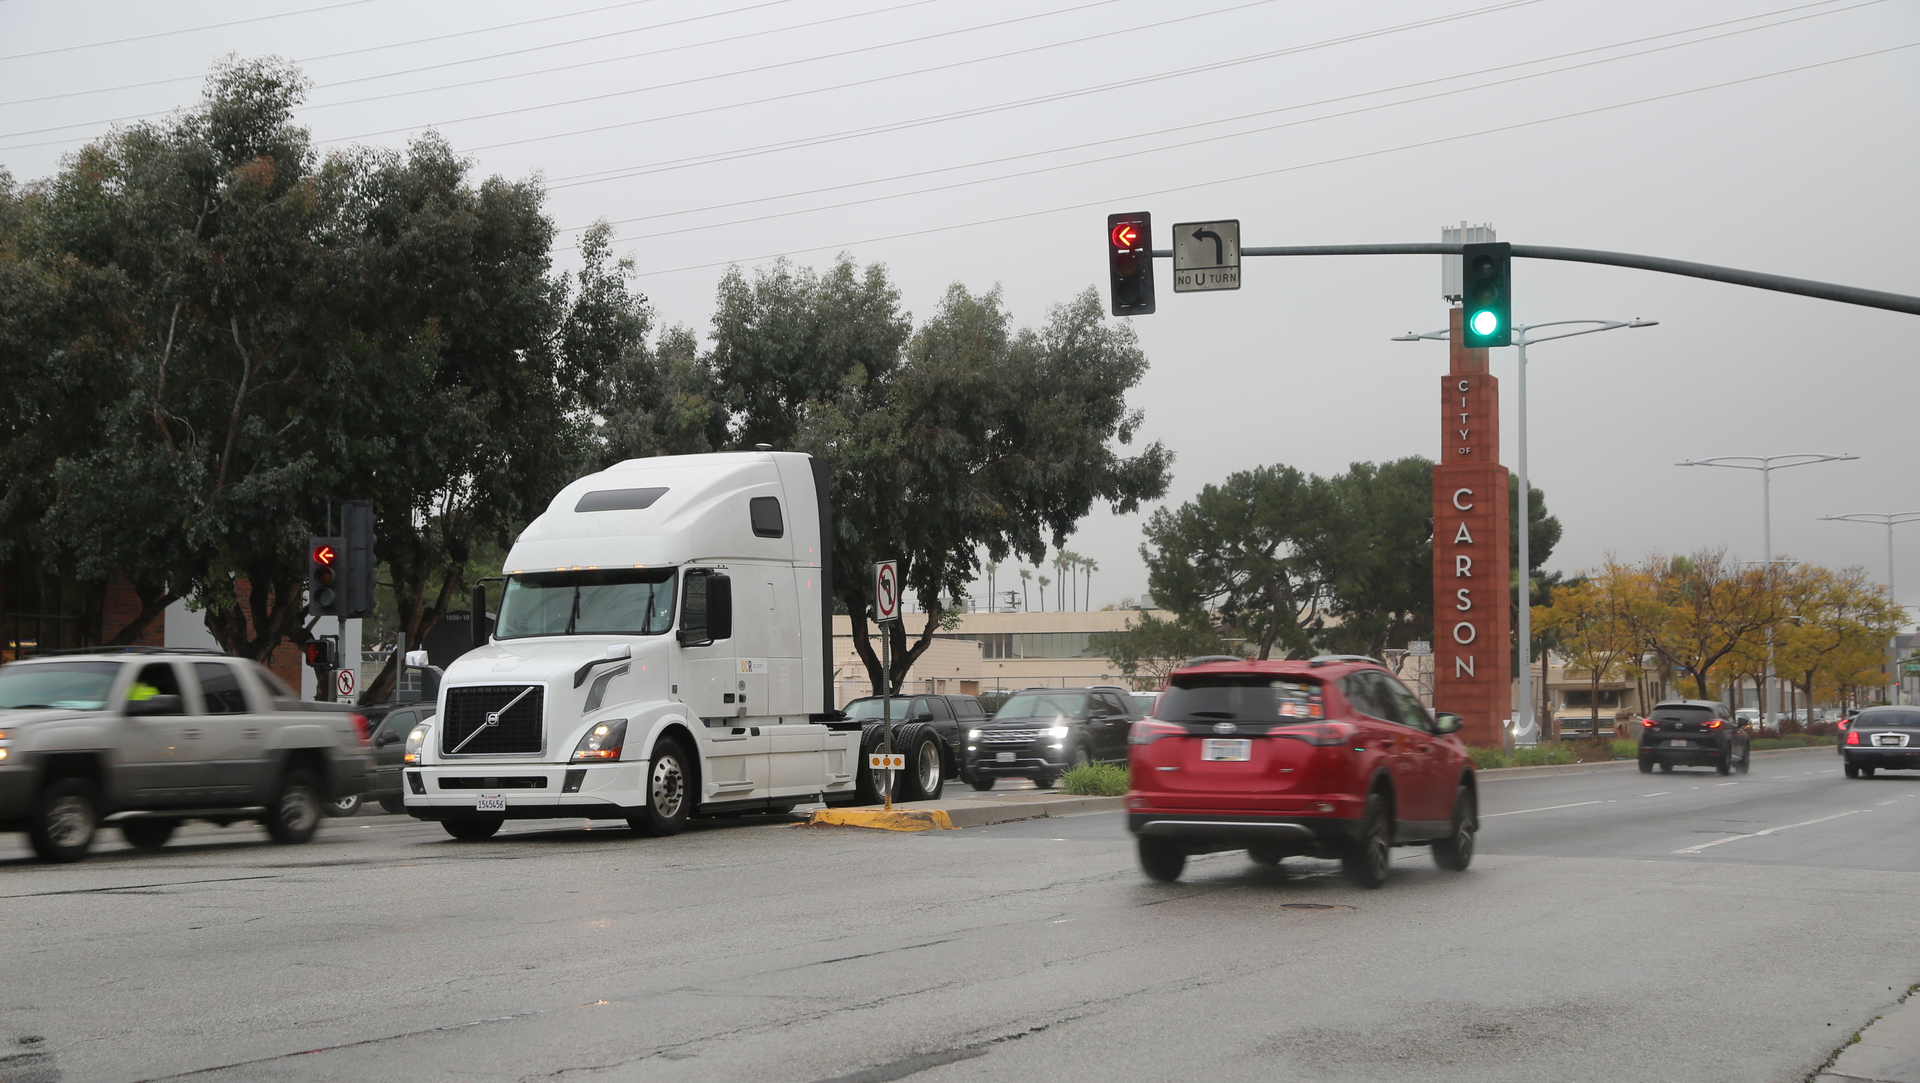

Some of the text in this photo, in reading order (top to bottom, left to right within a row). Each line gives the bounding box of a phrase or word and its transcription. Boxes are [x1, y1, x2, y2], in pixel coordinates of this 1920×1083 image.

[1178, 273, 1237, 286] NO U TURN
[1458, 380, 1469, 440] CITY
[1453, 488, 1476, 678] CARSON
[741, 660, 752, 672] UCR
[478, 800, 504, 809] 1545456
